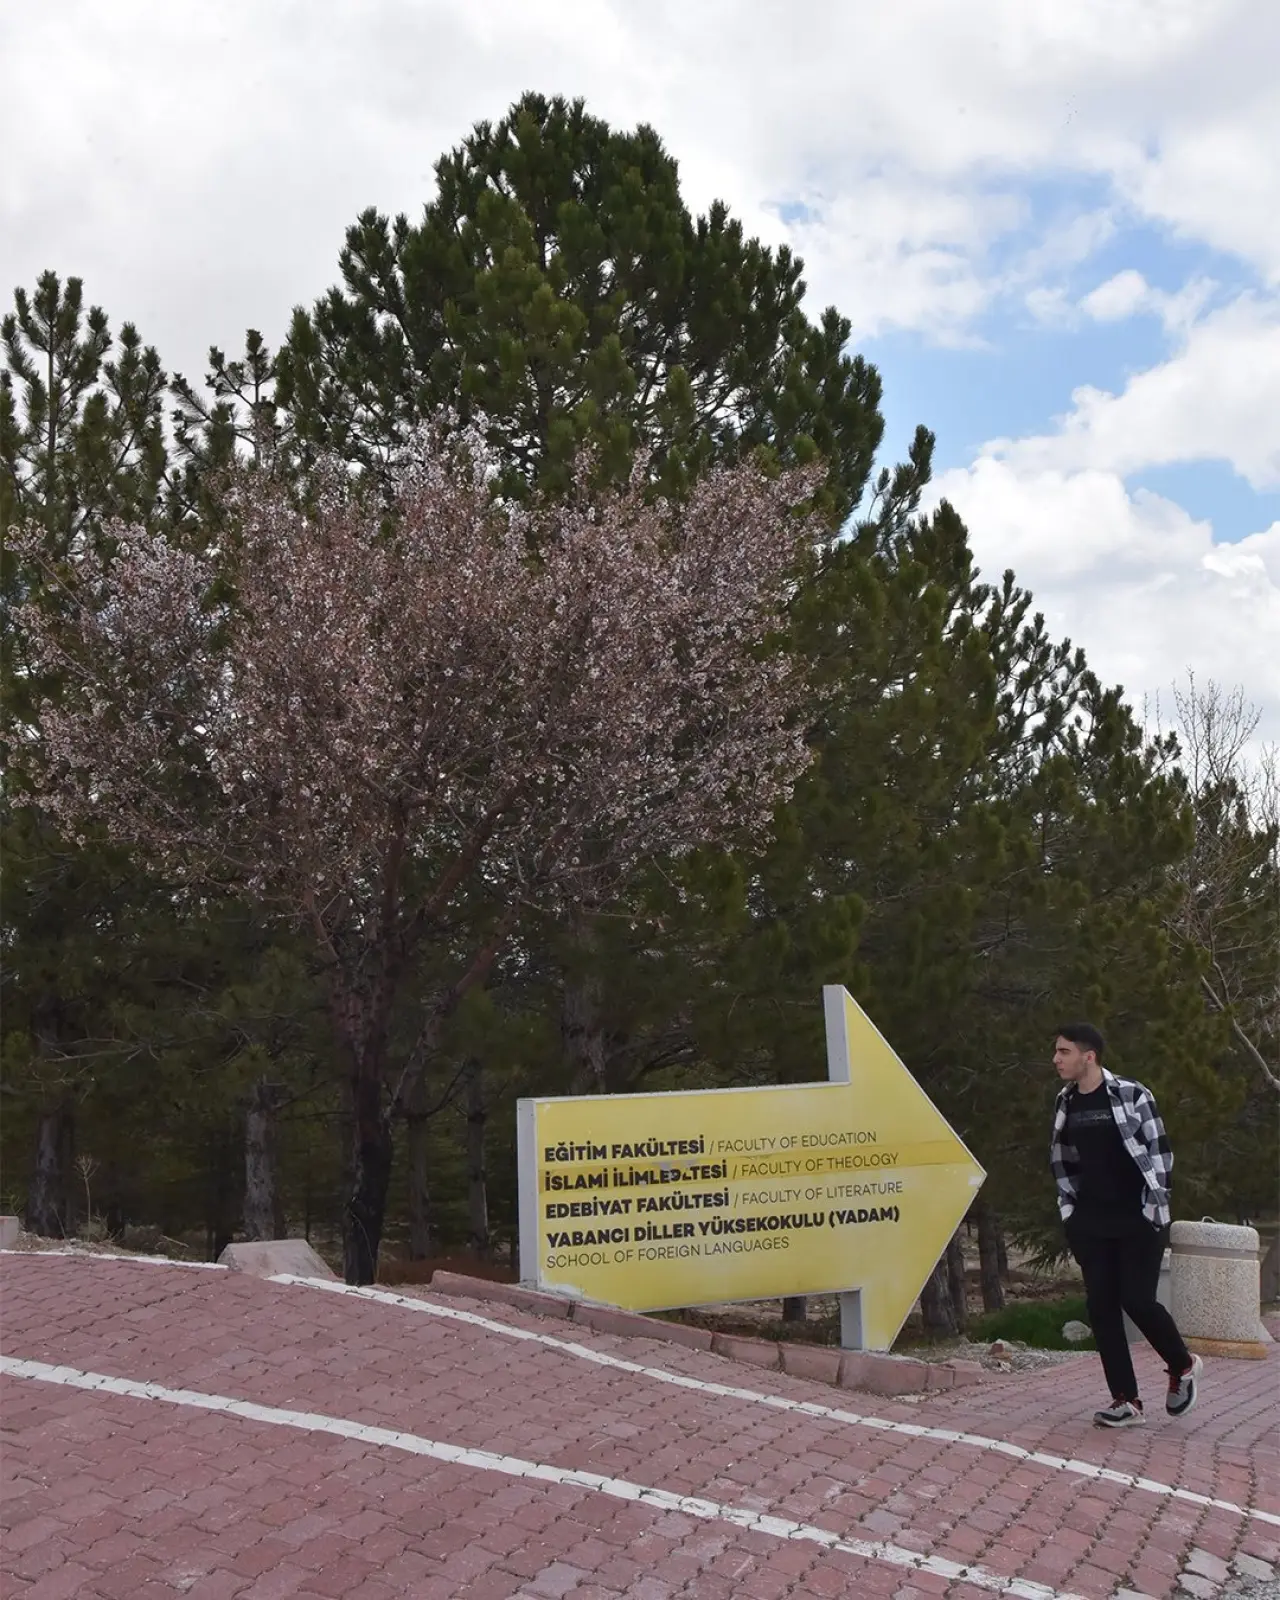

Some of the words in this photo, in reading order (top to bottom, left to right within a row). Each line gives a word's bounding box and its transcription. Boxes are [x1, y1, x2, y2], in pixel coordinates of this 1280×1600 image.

[545, 1141, 607, 1162] EĞİTİM
[612, 1134, 704, 1159] FAKÜLTESİ
[709, 1141, 714, 1155] /
[717, 1137, 776, 1152] FACULTY
[780, 1136, 798, 1149] OF
[802, 1131, 877, 1147] EDUCATION
[545, 1168, 608, 1191] İSLAMİ
[732, 1165, 737, 1180] /
[742, 1160, 801, 1176] FACULTY
[805, 1158, 824, 1172] OF
[827, 1152, 900, 1169] THEOLOGY
[546, 1196, 633, 1219] EDEBİYAT
[637, 1187, 729, 1213] FAKÜLTESİ
[734, 1193, 739, 1208] /
[742, 1189, 801, 1204] FACULTY
[805, 1188, 823, 1200] OF
[827, 1181, 903, 1198] LITERATURE
[547, 1228, 629, 1248] YABANCI
[634, 1221, 695, 1241] DİLLER
[698, 1211, 825, 1236] YÜKSEKOKULU
[829, 1205, 900, 1228] (YADAM)
[547, 1252, 609, 1268] SCHOOL
[614, 1249, 634, 1263] OF
[638, 1244, 700, 1261] FOREIGN
[705, 1236, 789, 1255] LANGUAGES
